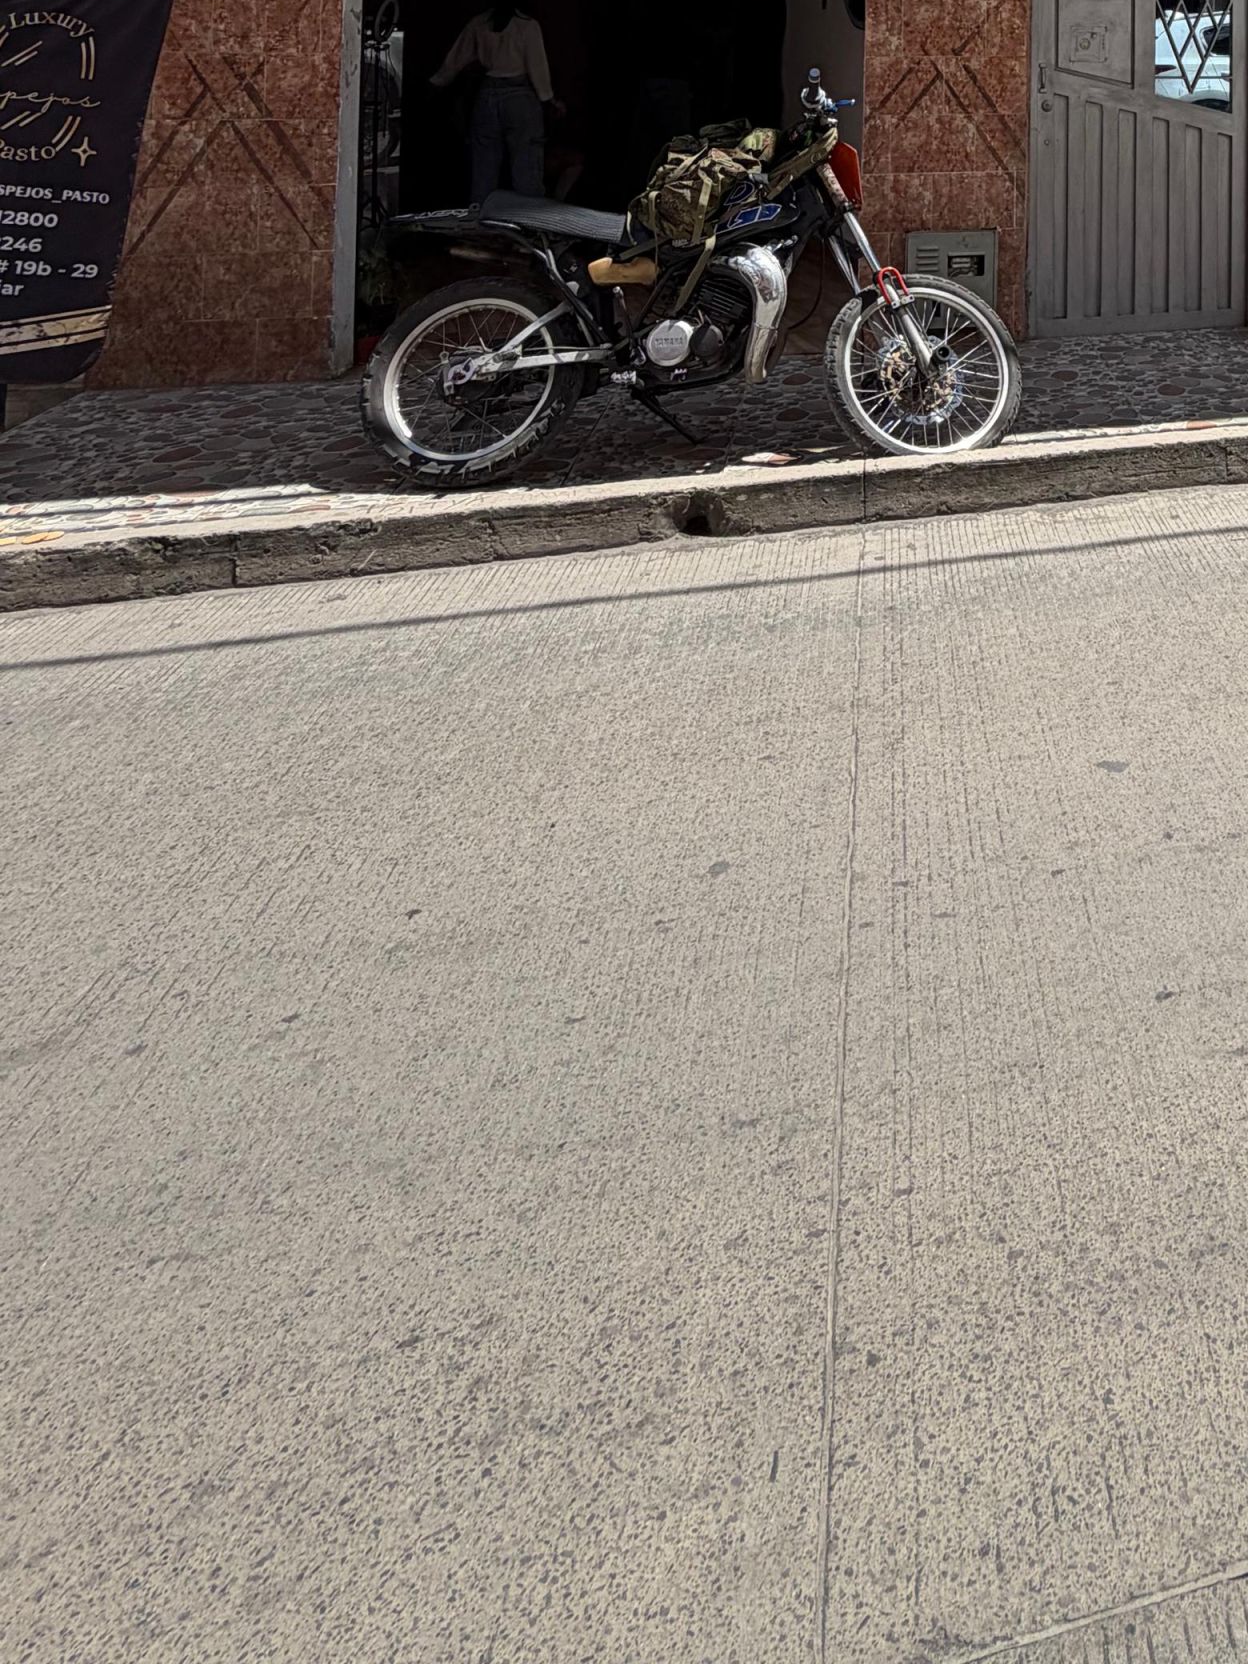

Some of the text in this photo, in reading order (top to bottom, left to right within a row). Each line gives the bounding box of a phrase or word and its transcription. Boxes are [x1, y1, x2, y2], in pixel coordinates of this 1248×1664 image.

[8, 12, 95, 38] Luxury
[15, 260, 52, 276] 19b
[71, 263, 98, 278] 29
